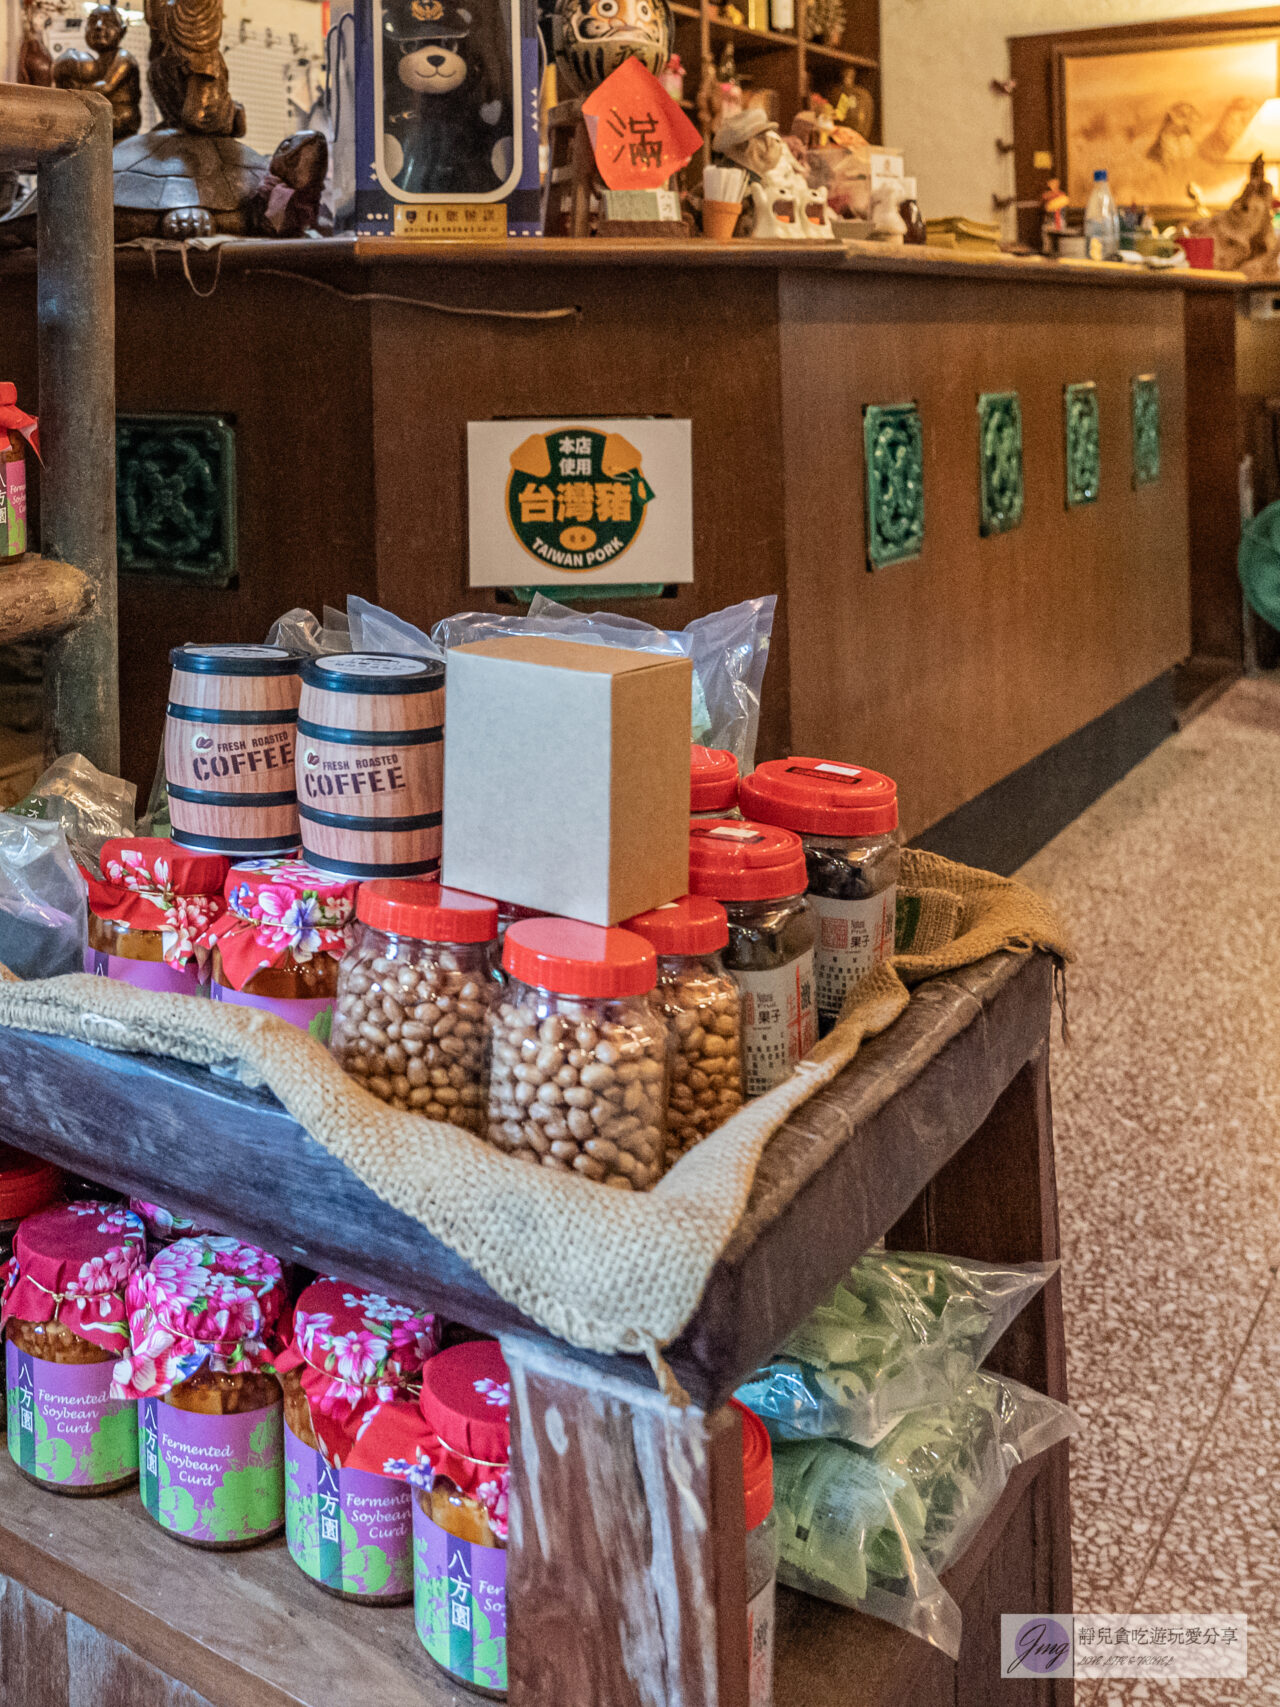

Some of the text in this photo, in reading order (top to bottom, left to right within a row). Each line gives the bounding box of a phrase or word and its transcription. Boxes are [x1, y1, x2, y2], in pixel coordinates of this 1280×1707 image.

[558, 436, 592, 455] 本店
[558, 458, 592, 477] 使用
[519, 482, 632, 522] 台灣豬
[532, 536, 624, 567] TAIWAN PORK
[217, 731, 289, 753] FRESH ROASTED
[192, 742, 295, 781] COFFEE
[322, 754, 399, 771] FRESH ROASTED
[304, 766, 406, 798] COFFEE
[19, 1363, 33, 1433] 八方園
[38, 1388, 110, 1405] Fermented
[42, 1404, 100, 1421] Soybean
[56, 1421, 93, 1434] Curd
[145, 1404, 158, 1477] 八方園
[162, 1433, 234, 1457] Fermented
[165, 1450, 223, 1472] Soybean
[179, 1470, 216, 1487] Curd
[318, 1466, 339, 1543] 八方園
[351, 1509, 412, 1527] Soybean
[369, 1523, 408, 1539] Curd
[448, 1549, 471, 1632] 八方園
